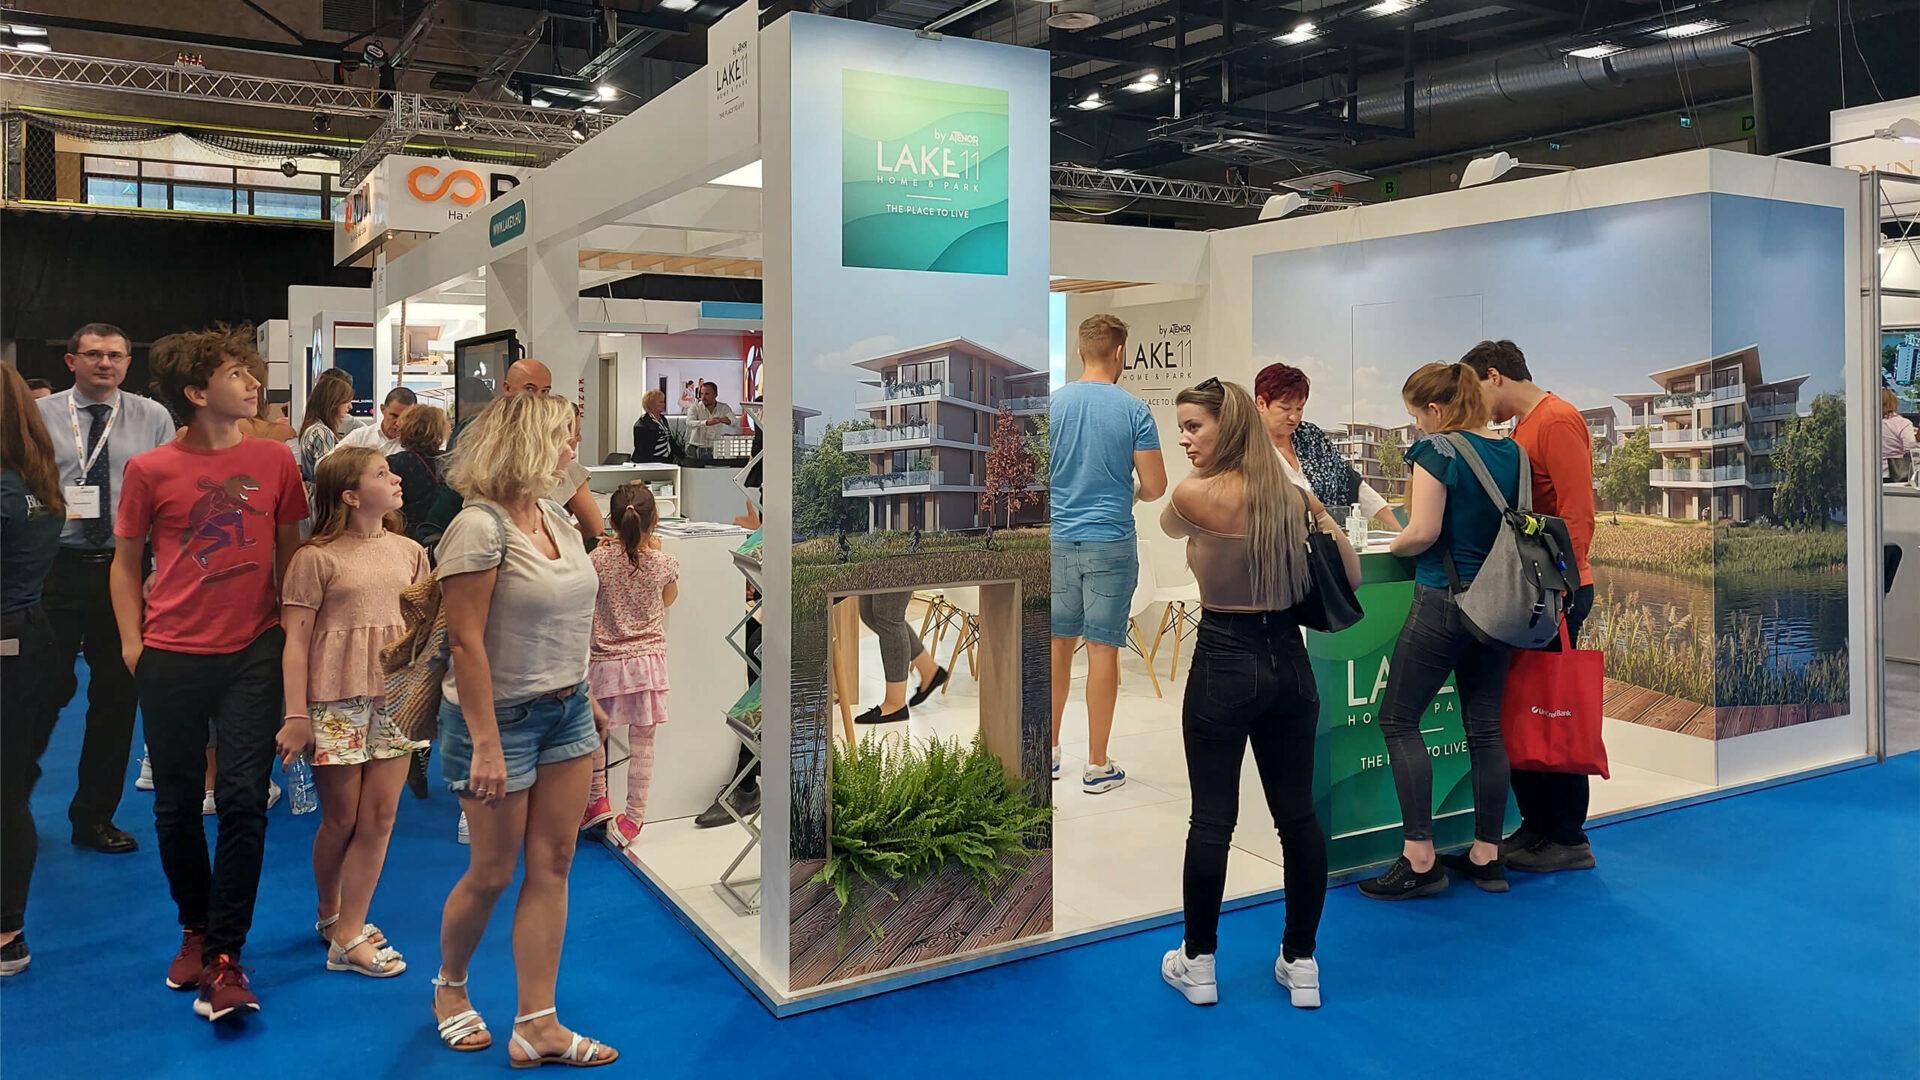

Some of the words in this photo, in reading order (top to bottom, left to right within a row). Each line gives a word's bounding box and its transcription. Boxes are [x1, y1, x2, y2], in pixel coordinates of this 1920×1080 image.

[1742, 115, 1756, 131] D
[935, 128, 946, 144] by
[877, 176, 918, 187] HOME
[943, 182, 979, 192] PARK
[1386, 182, 1394, 193] B
[886, 203, 904, 214] THE
[906, 205, 934, 216] PLACE
[937, 208, 949, 217] TO
[951, 209, 969, 219] LIVE
[1159, 324, 1167, 338] by
[1122, 373, 1148, 381] HOME
[1166, 372, 1192, 380] PARK
[1348, 712, 1372, 727] HO
[1434, 701, 1454, 714] PA
[1360, 755, 1384, 770] THE
[1444, 741, 1467, 756] LIVE
